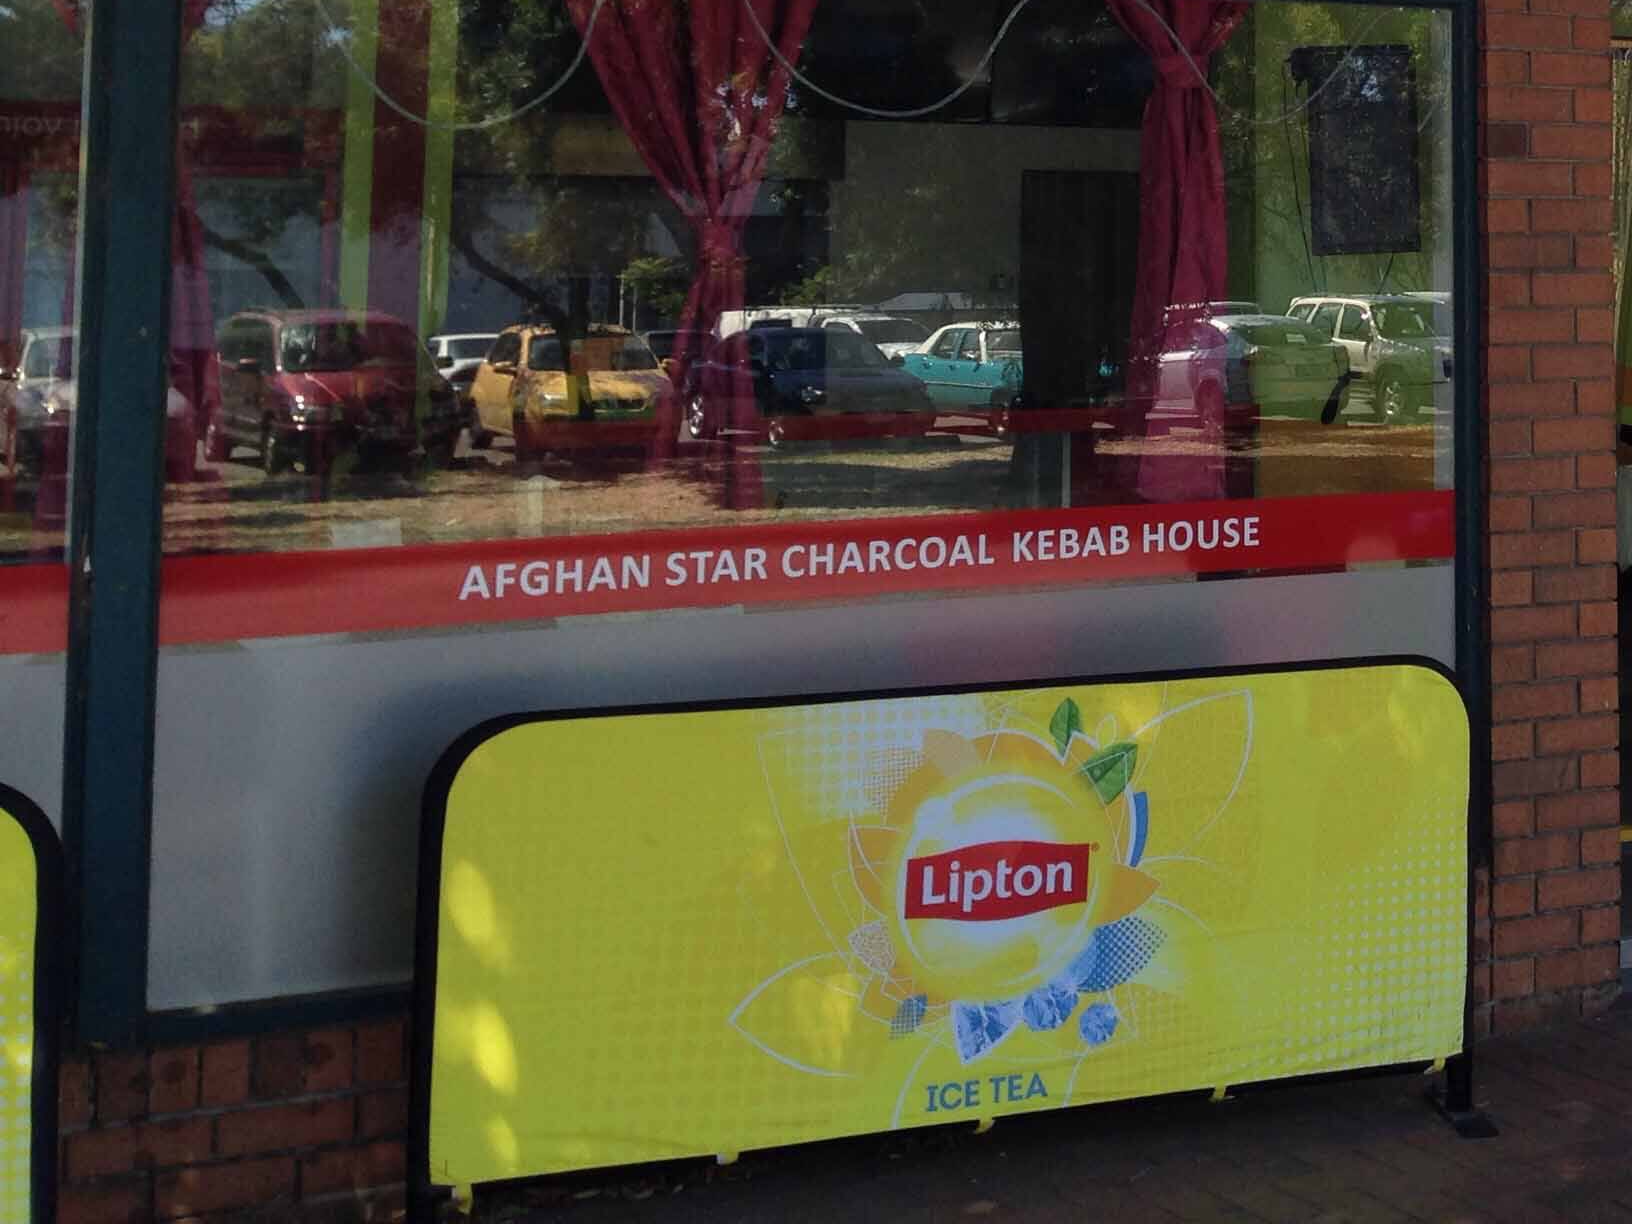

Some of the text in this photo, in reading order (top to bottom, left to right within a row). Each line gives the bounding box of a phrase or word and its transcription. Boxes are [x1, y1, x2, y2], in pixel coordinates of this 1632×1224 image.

[458, 516, 1261, 600] AFGHAN STAR CHARCOAL KEBAB HOUSE
[920, 858, 1074, 913] Lipton
[925, 1072, 1049, 1113] ICE TEA
